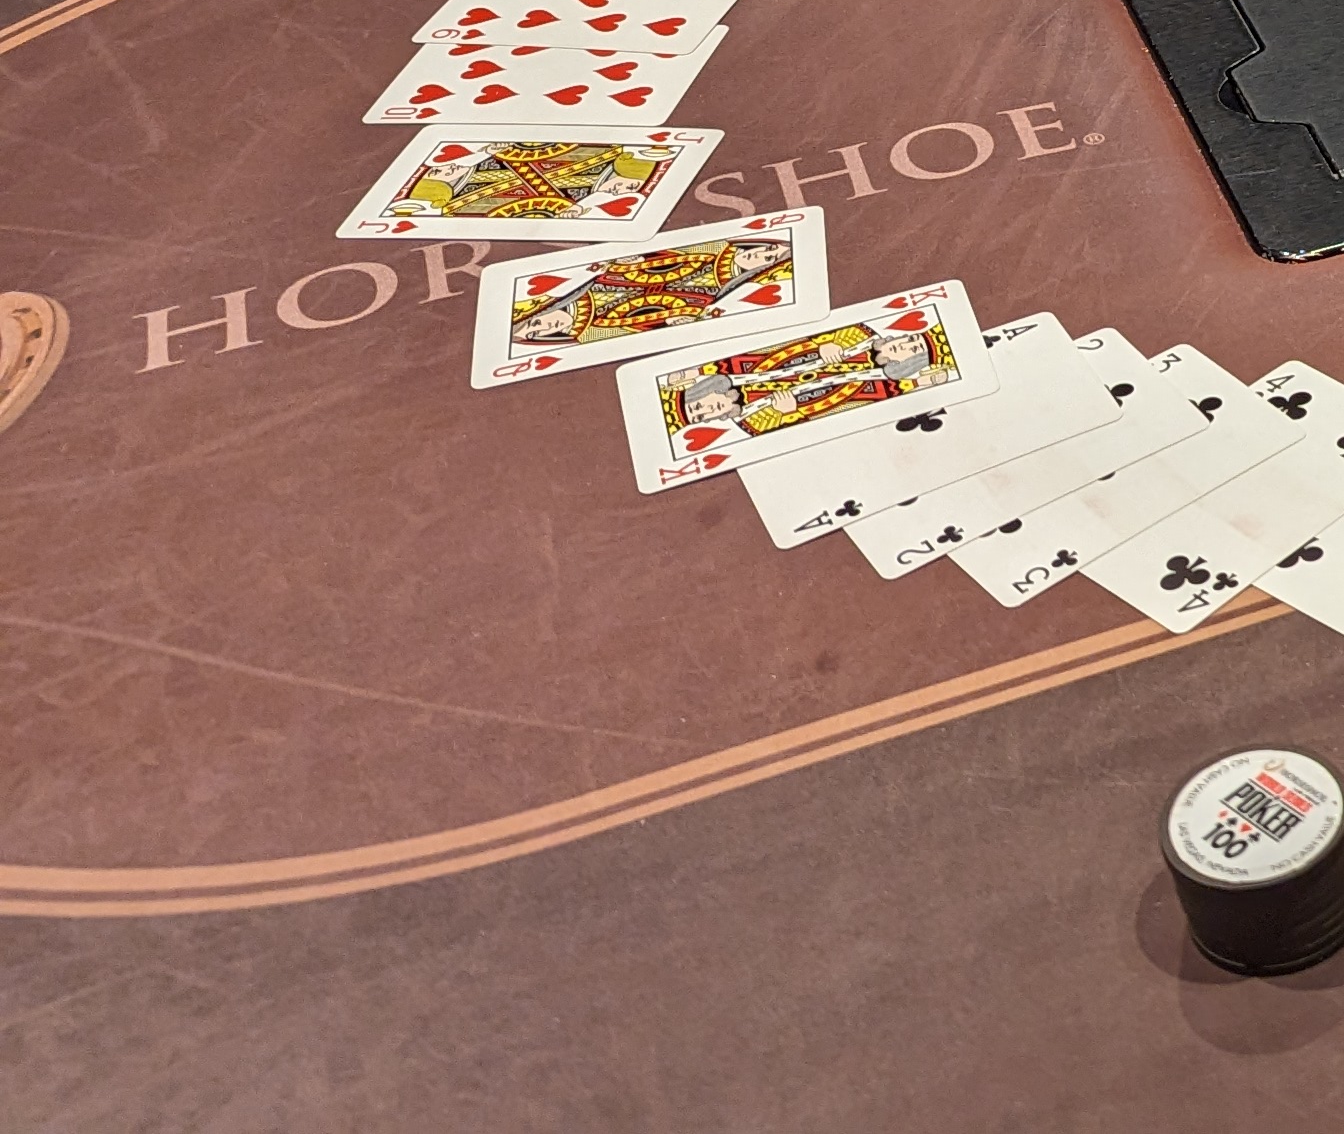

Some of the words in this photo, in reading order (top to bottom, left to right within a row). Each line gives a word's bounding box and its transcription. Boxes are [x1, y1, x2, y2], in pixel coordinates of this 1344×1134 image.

[380, 106, 416, 120] 10
[674, 130, 704, 145] J
[356, 219, 391, 235] J
[767, 210, 806, 227] Q
[909, 285, 949, 307] K
[1003, 322, 1039, 341] A
[491, 358, 536, 381] Q
[1157, 351, 1184, 375] 3
[1266, 373, 1296, 394] 4
[658, 456, 701, 486] K
[793, 509, 833, 534] A
[896, 538, 935, 567] 2
[1012, 566, 1051, 596] 3
[1177, 588, 1213, 616] 4
[1223, 781, 1303, 840] POKER
[1202, 822, 1249, 859] 100
